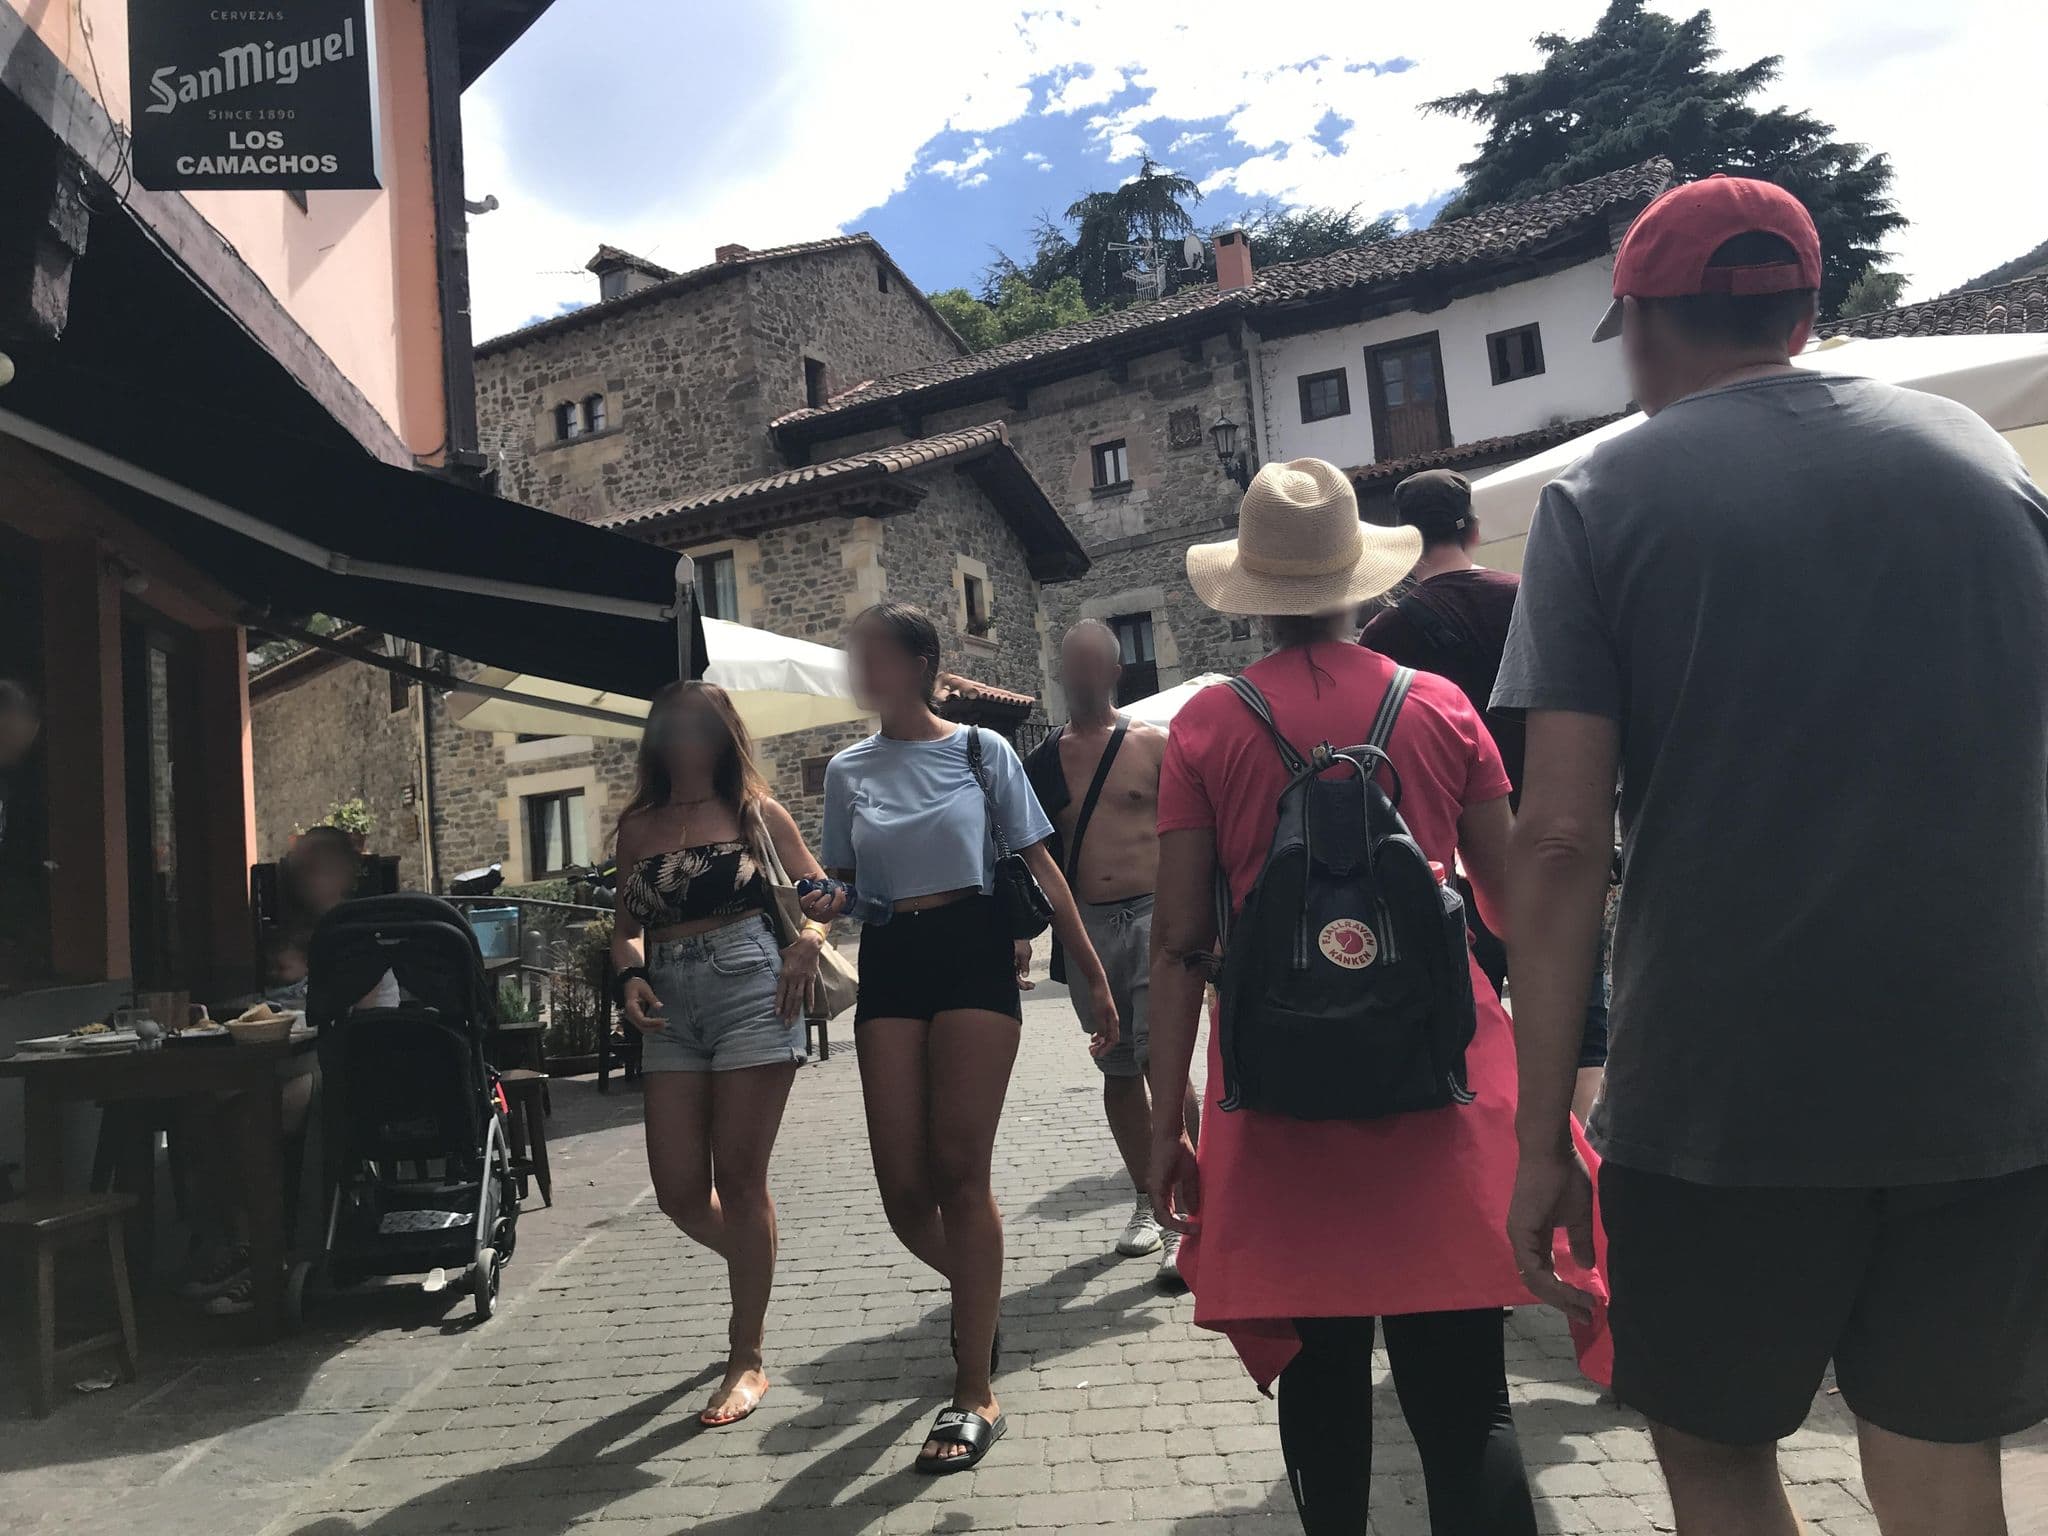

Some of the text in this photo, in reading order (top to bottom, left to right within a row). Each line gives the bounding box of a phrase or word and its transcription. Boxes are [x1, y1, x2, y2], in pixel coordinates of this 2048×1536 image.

[210, 10, 285, 21] CERVEZAS
[208, 109, 296, 120] SINCE 1890
[229, 131, 285, 150] LOS
[176, 154, 339, 175] CAMACHOS
[938, 1411, 967, 1423] NIKE
